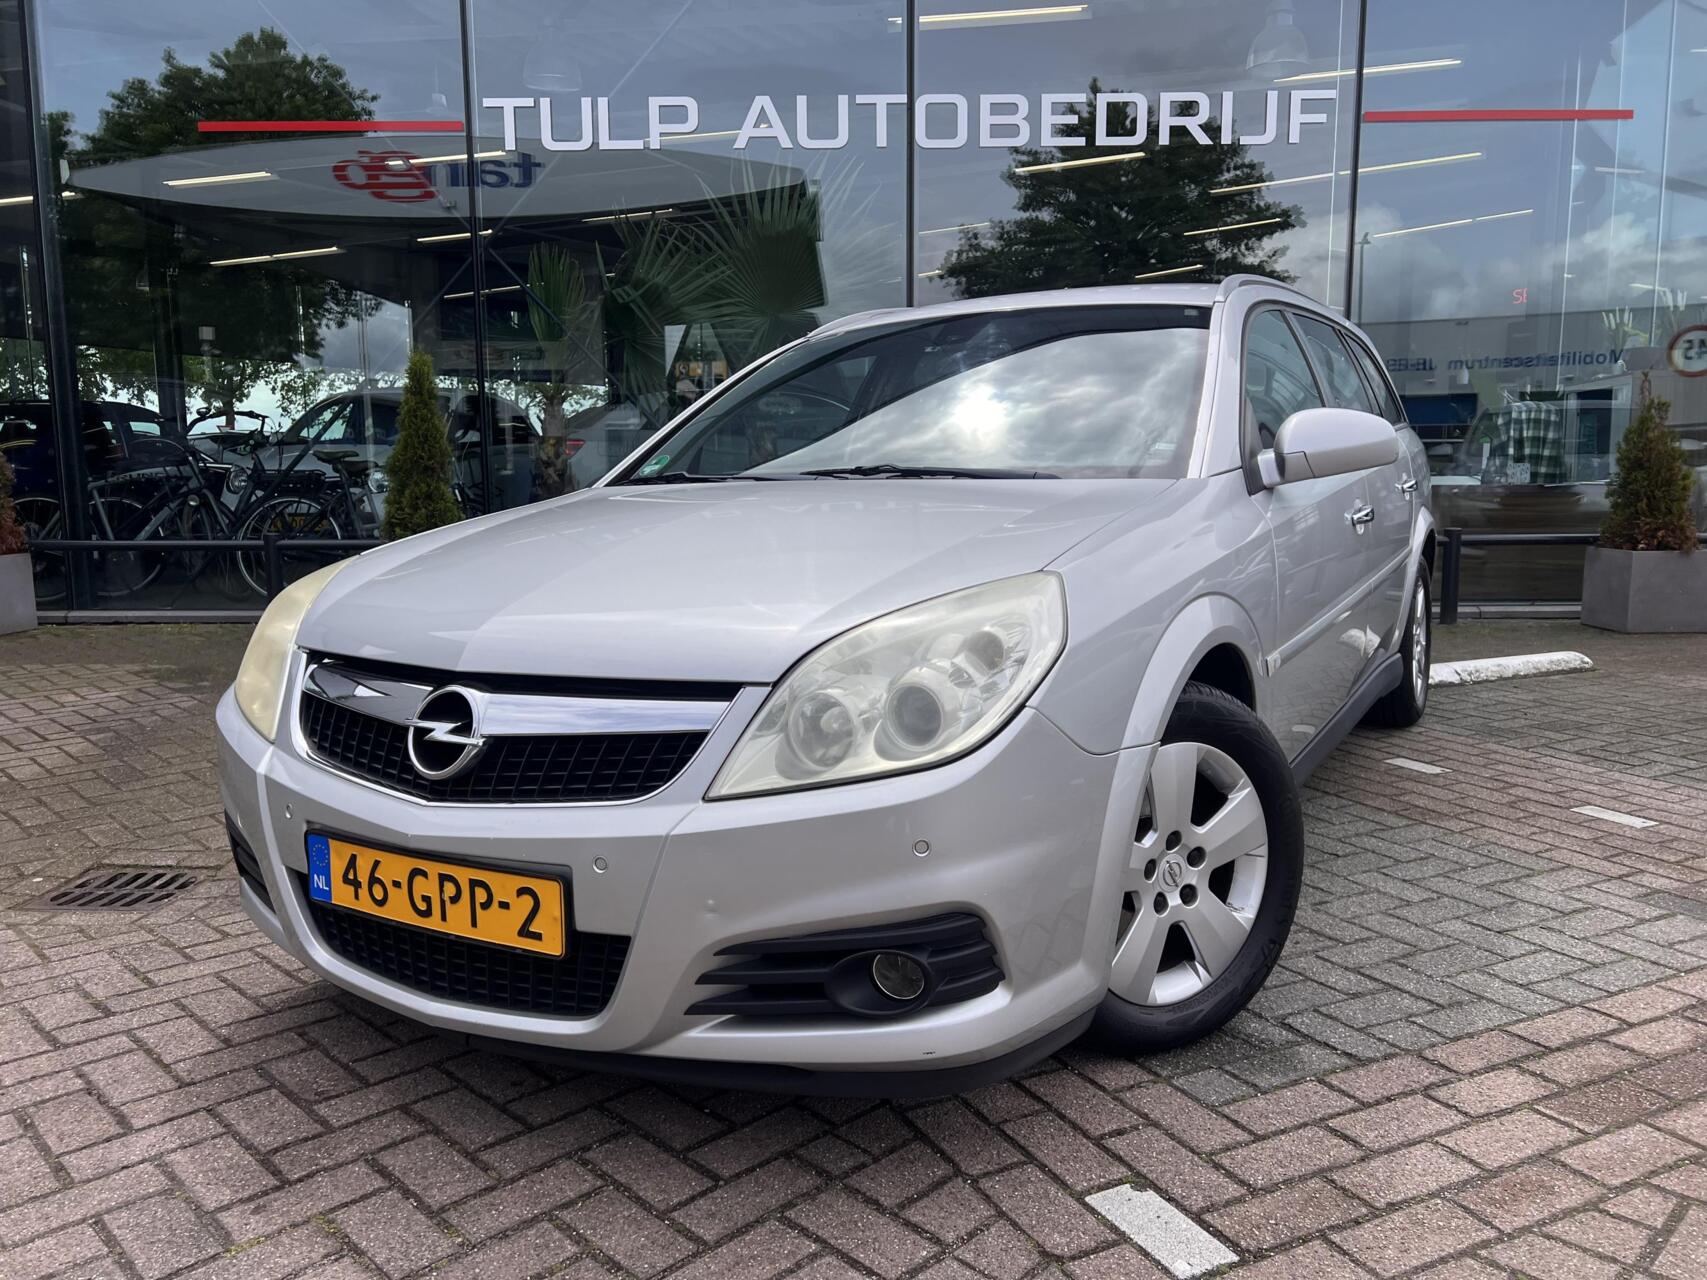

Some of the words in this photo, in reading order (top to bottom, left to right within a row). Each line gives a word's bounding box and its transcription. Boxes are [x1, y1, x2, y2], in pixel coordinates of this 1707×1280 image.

[483, 95, 699, 151] TULP
[733, 90, 1337, 149] AUTOBEDRIJF
[313, 873, 329, 891] NL
[341, 853, 543, 942] 46-GPP-2
